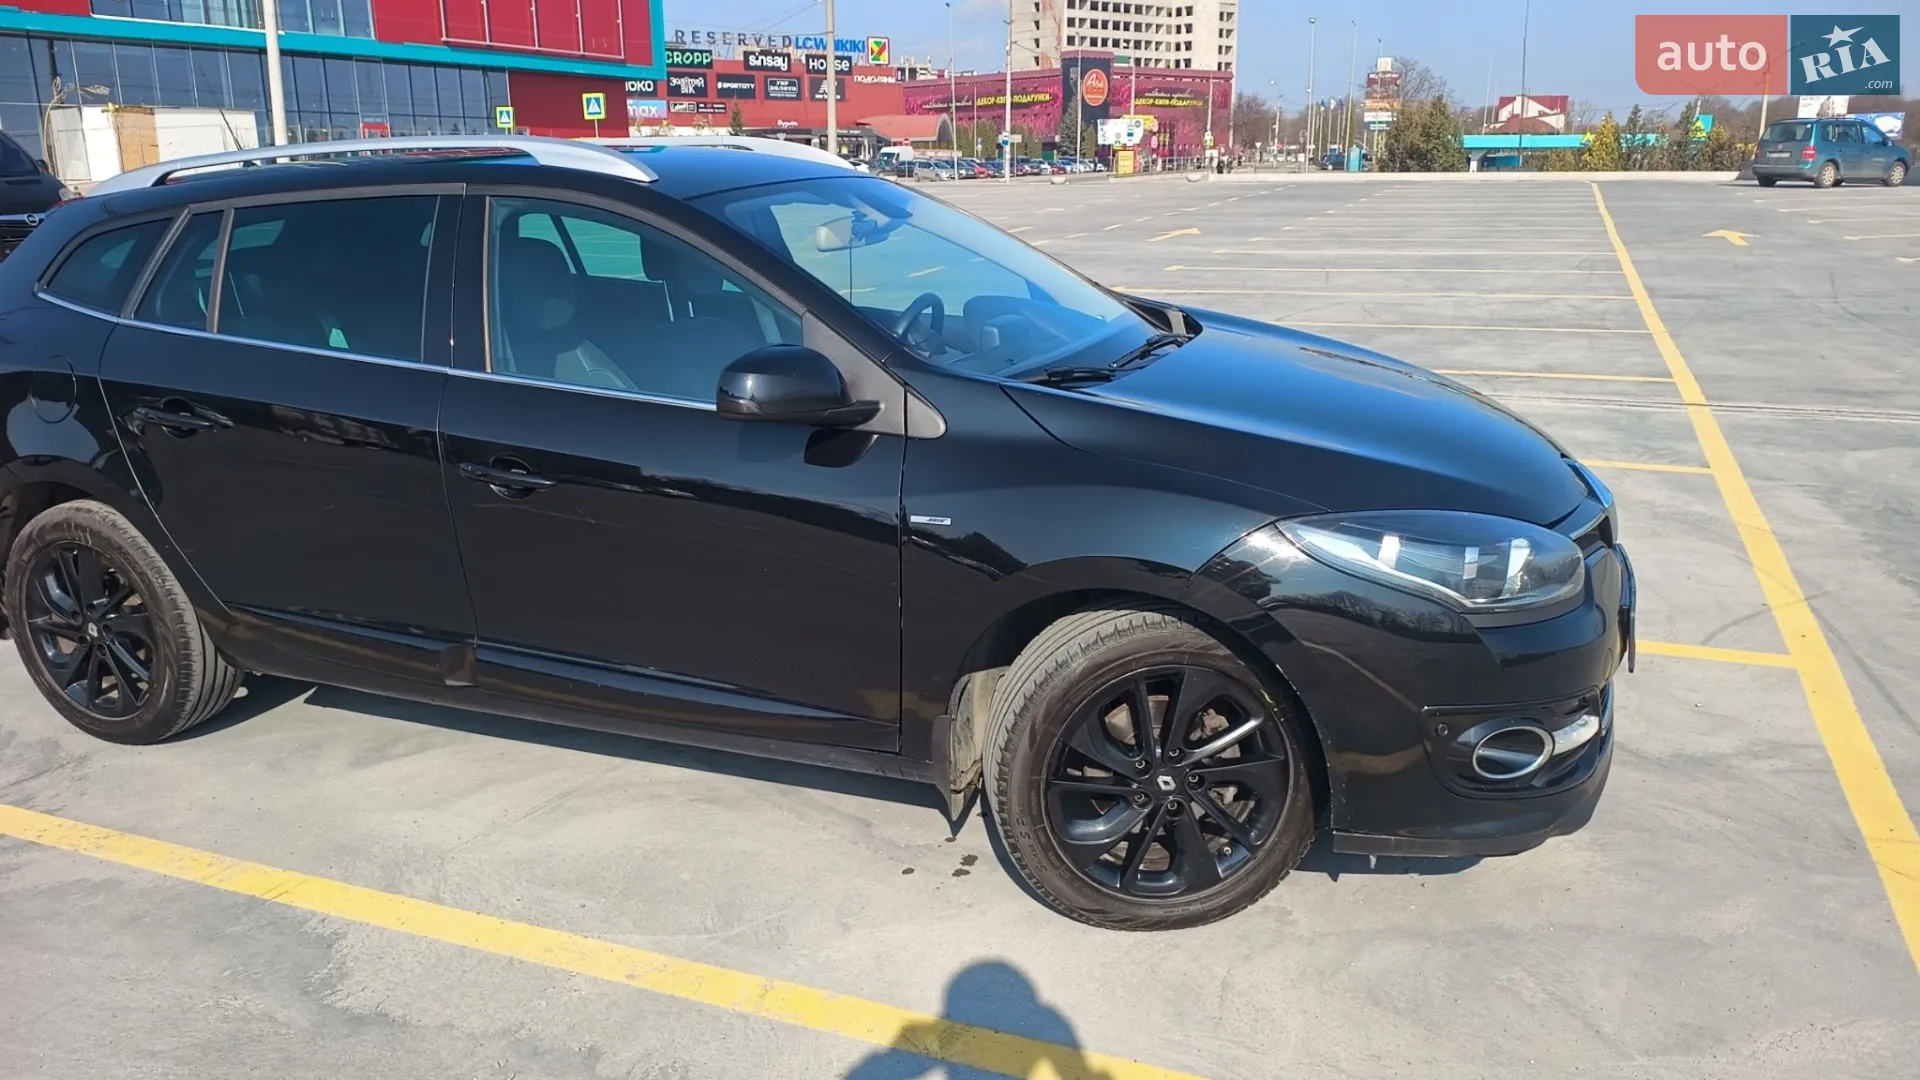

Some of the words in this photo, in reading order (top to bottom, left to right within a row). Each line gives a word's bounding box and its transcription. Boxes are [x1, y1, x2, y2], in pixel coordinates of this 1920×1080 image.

[674, 29, 792, 48] RESERVED
[795, 36, 865, 53] LCWIKIKI
[665, 51, 711, 66] CROPP
[748, 52, 788, 71] sinsay
